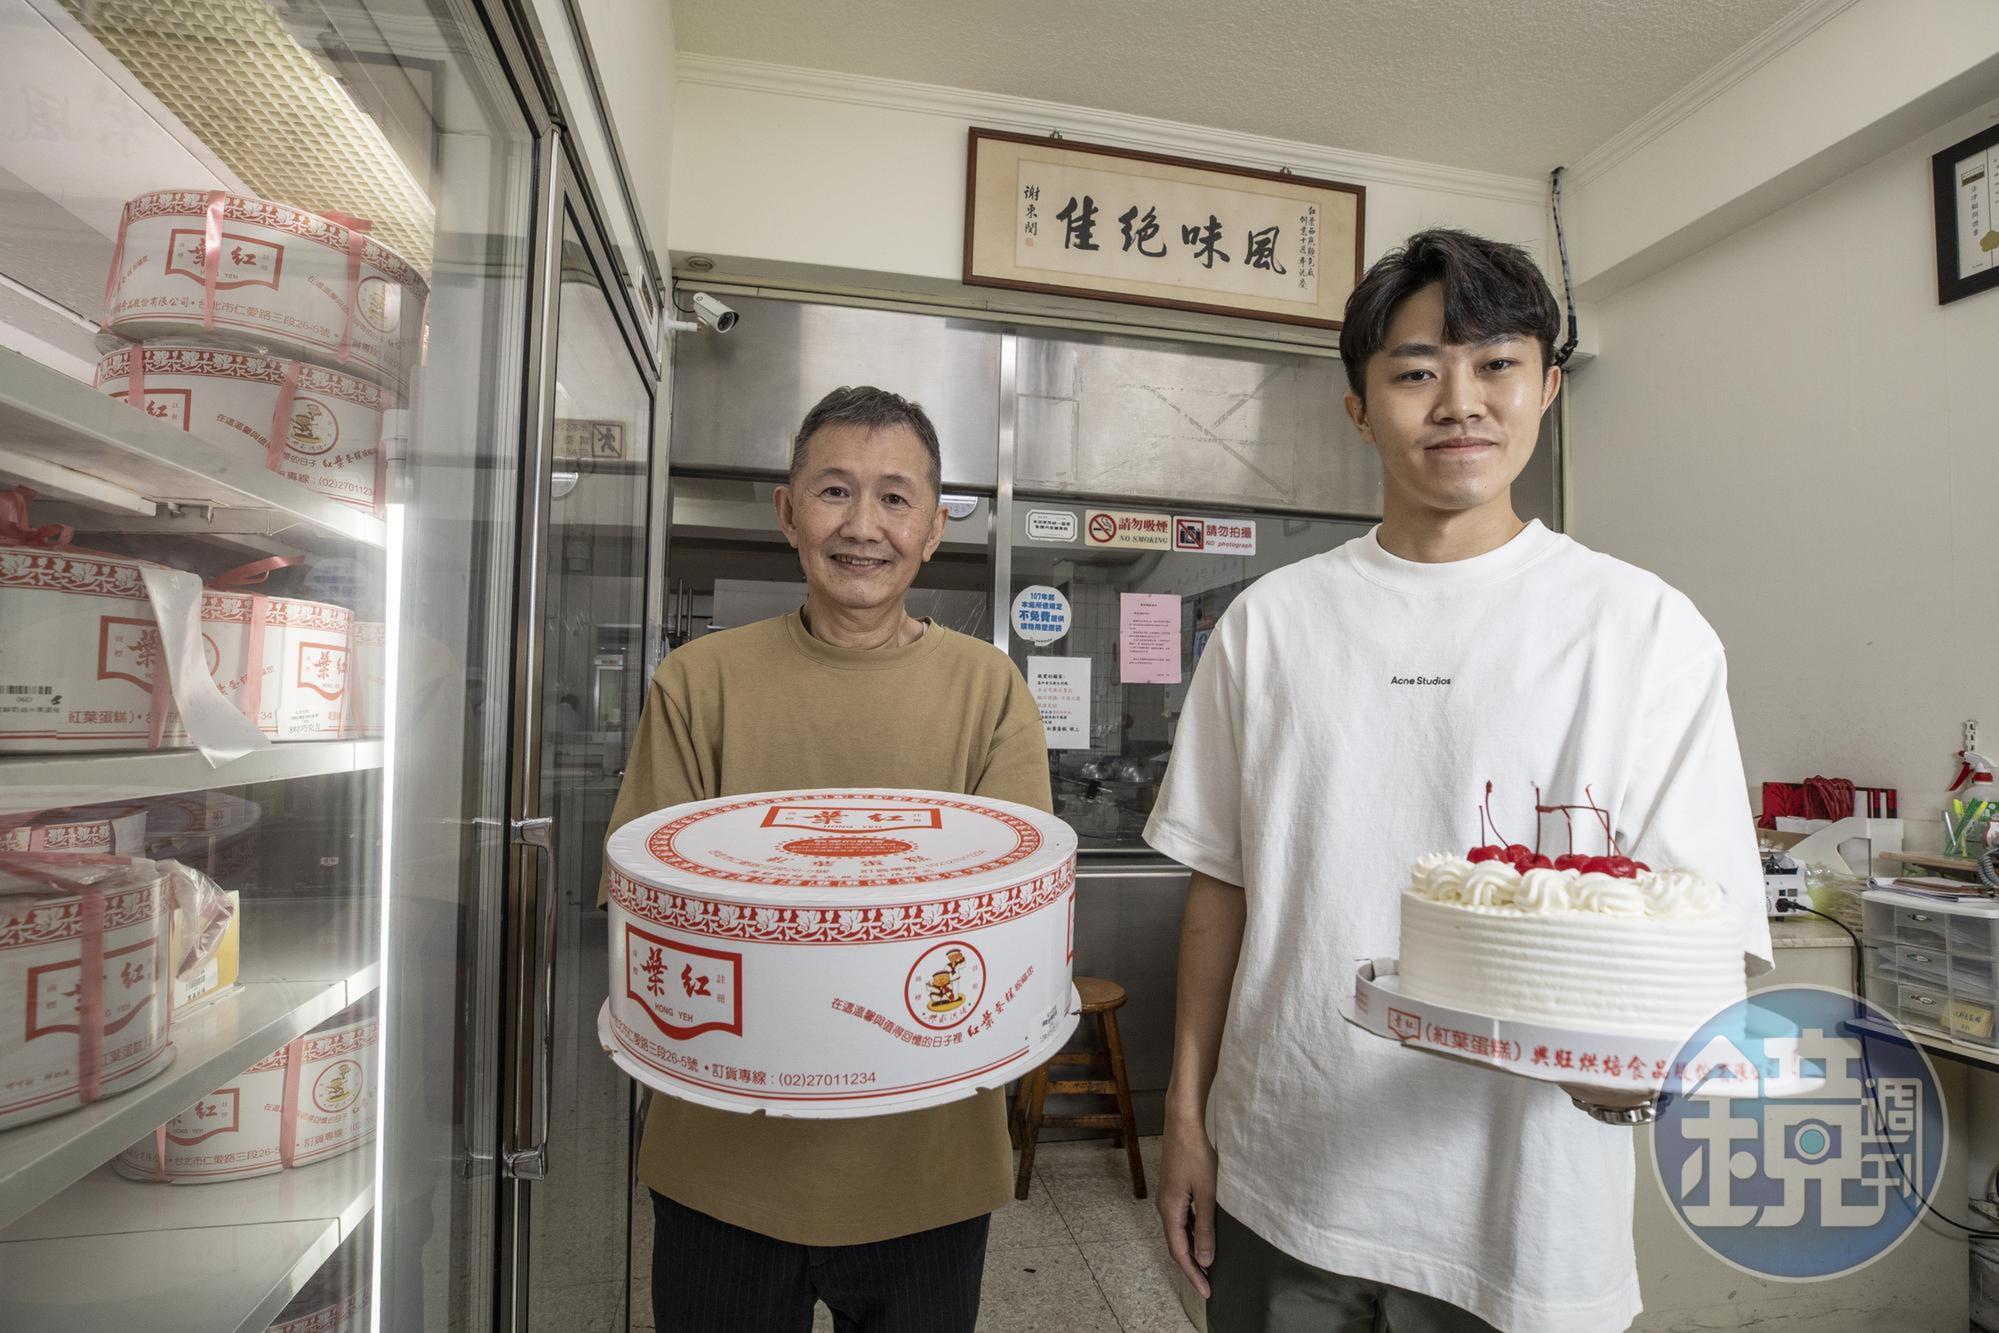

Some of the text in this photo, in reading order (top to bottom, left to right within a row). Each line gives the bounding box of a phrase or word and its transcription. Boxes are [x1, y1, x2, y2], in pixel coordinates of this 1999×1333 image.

[1120, 535, 1168, 545] NO SMOKING
[1391, 676, 1451, 685] Acne Studios
[640, 946, 712, 998] 紅葉
[655, 1003, 694, 1023] HONG YEH
